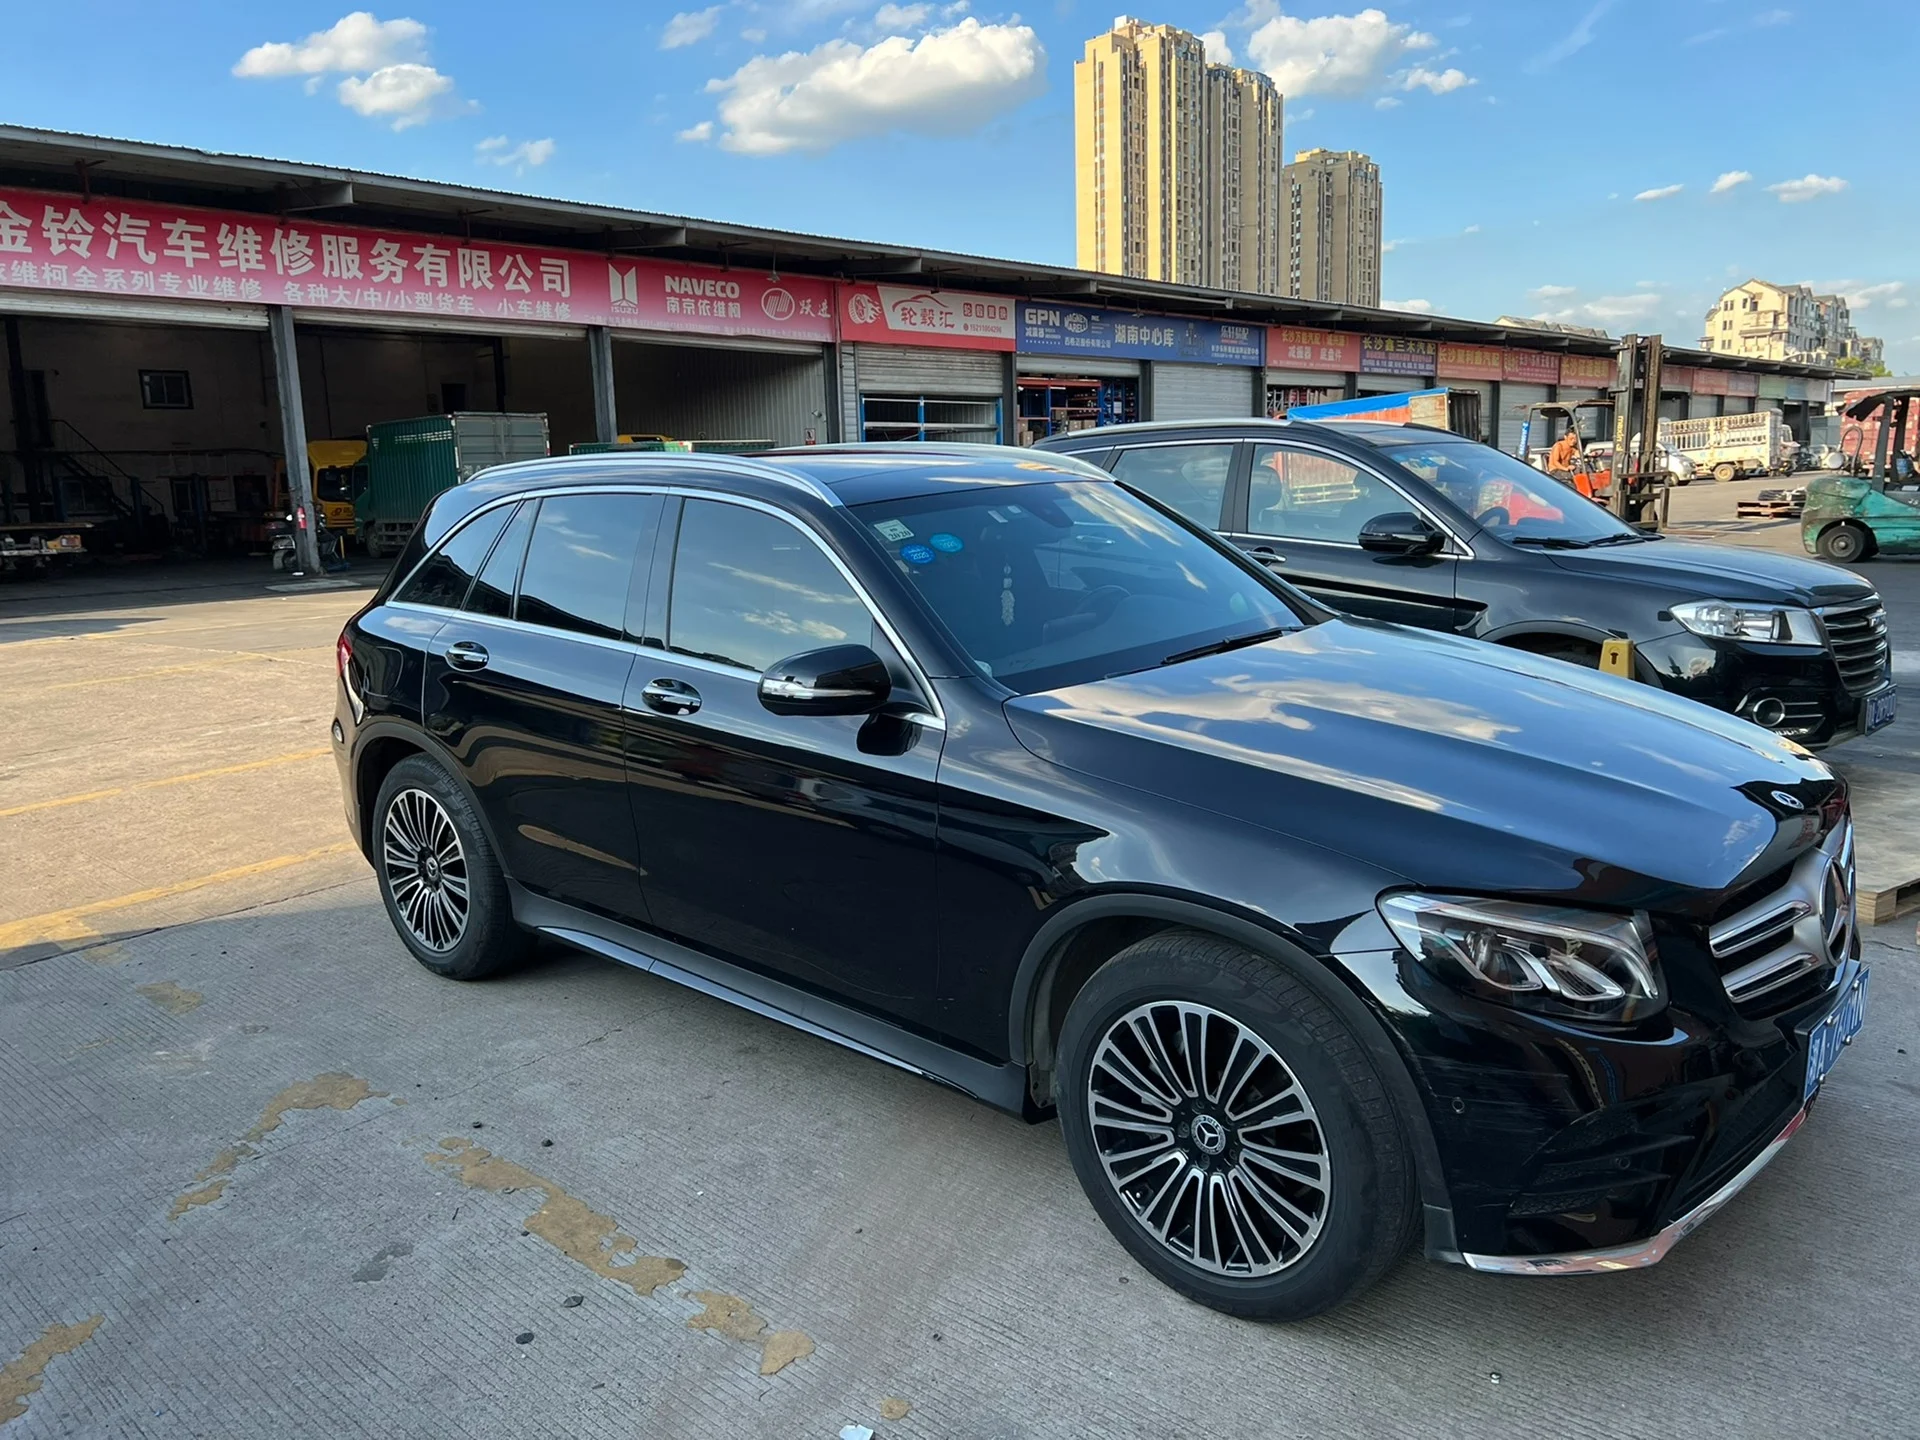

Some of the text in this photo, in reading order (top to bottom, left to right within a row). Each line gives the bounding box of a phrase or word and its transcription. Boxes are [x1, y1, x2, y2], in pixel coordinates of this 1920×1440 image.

[0, 259, 262, 299] 维柯全系列专业维修
[664, 275, 740, 299] NAVECO
[665, 296, 742, 320] 南京依维柯
[1024, 308, 1060, 328] GPN
[1114, 323, 1175, 347] 湖南中心库
